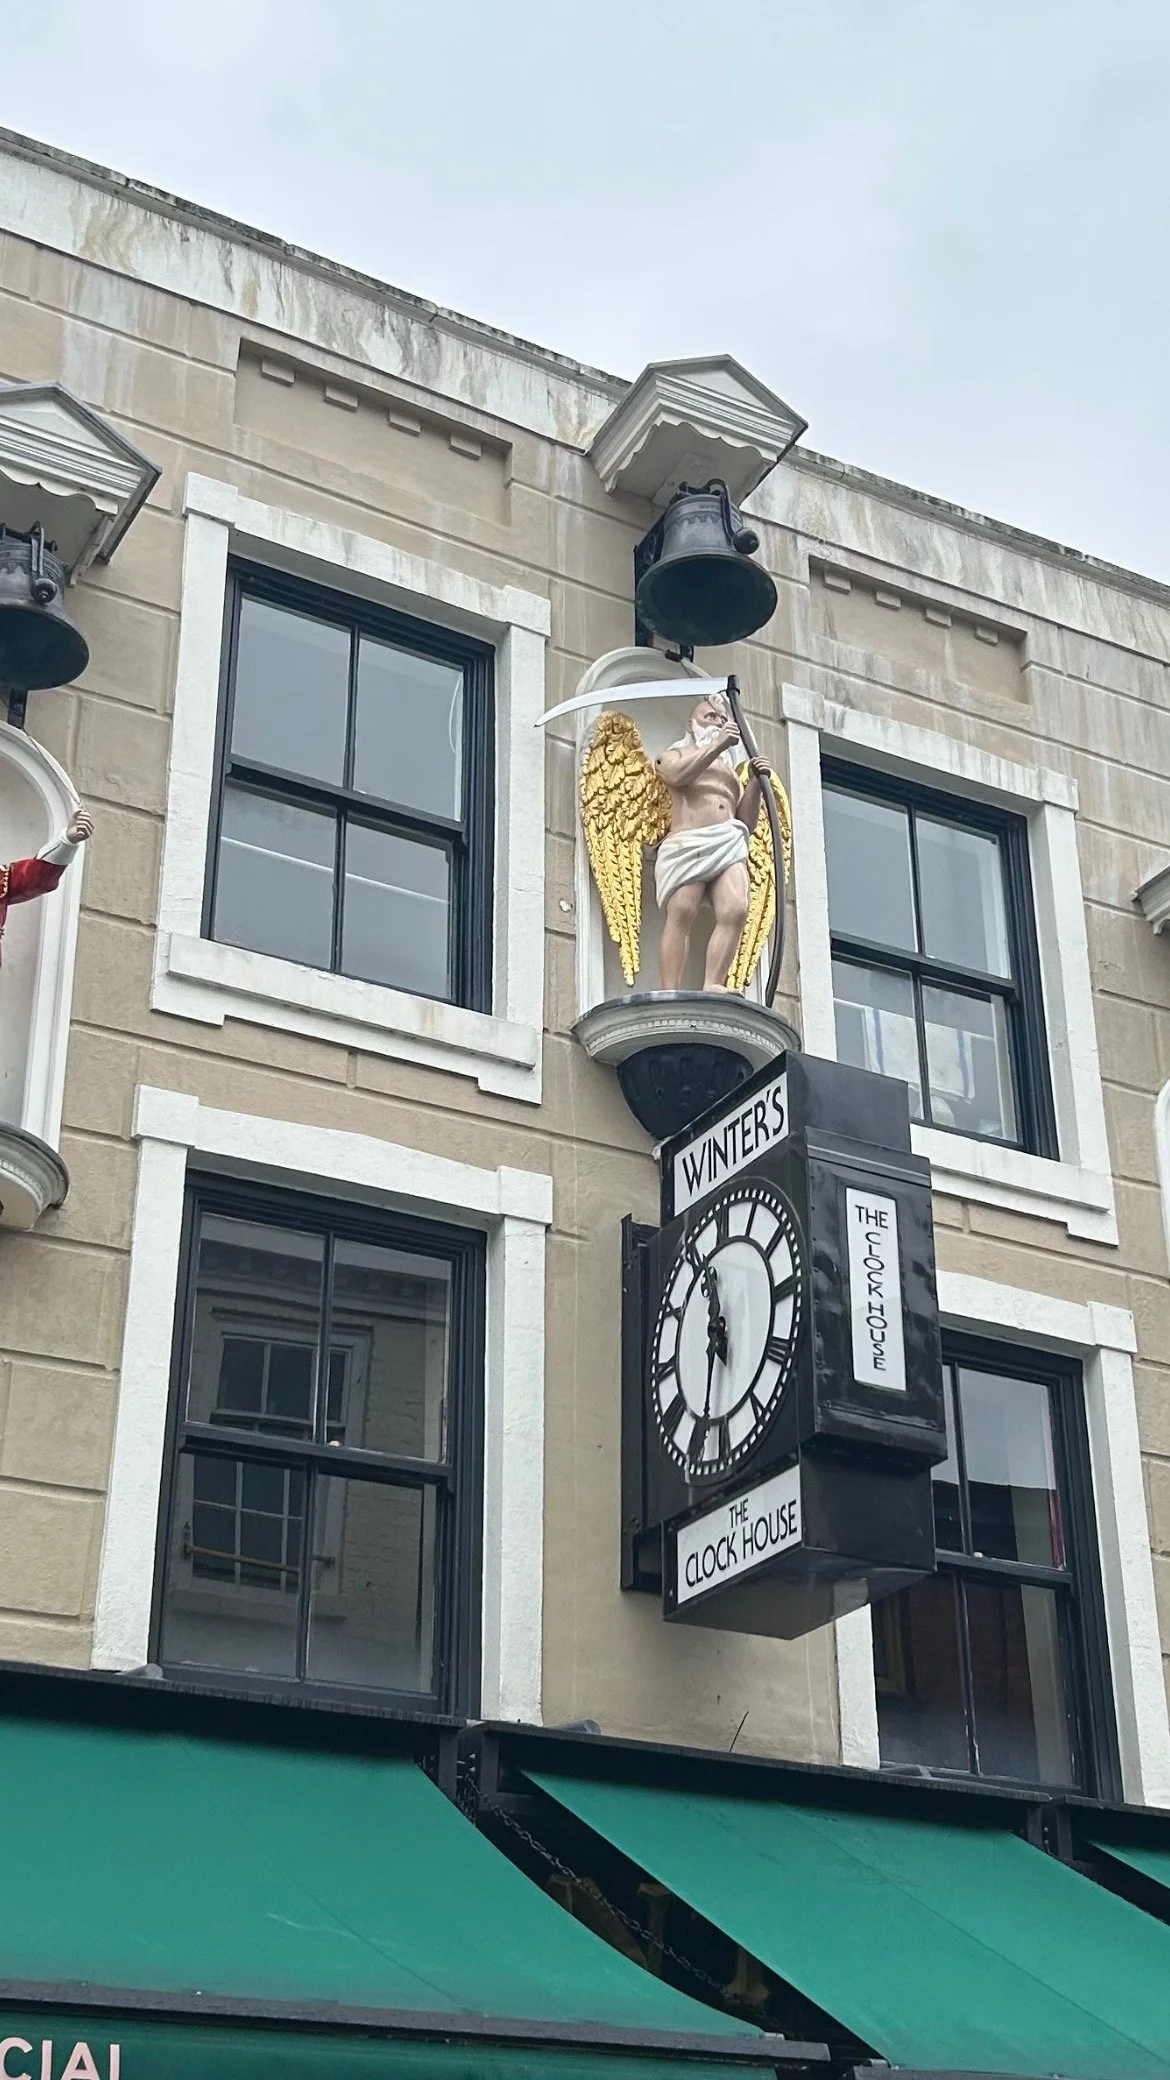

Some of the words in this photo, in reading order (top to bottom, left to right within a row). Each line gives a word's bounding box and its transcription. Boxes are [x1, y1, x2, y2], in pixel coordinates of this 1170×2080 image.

[682, 1086, 785, 1197] WINTER'S
[855, 1204, 889, 1229] THE
[862, 1231, 885, 1299] CLOCK
[865, 1301, 888, 1371] HOUSE
[685, 1531, 737, 1587] CLOCK
[742, 1499, 798, 1559] HOUSE
[729, 1498, 749, 1529] THE
